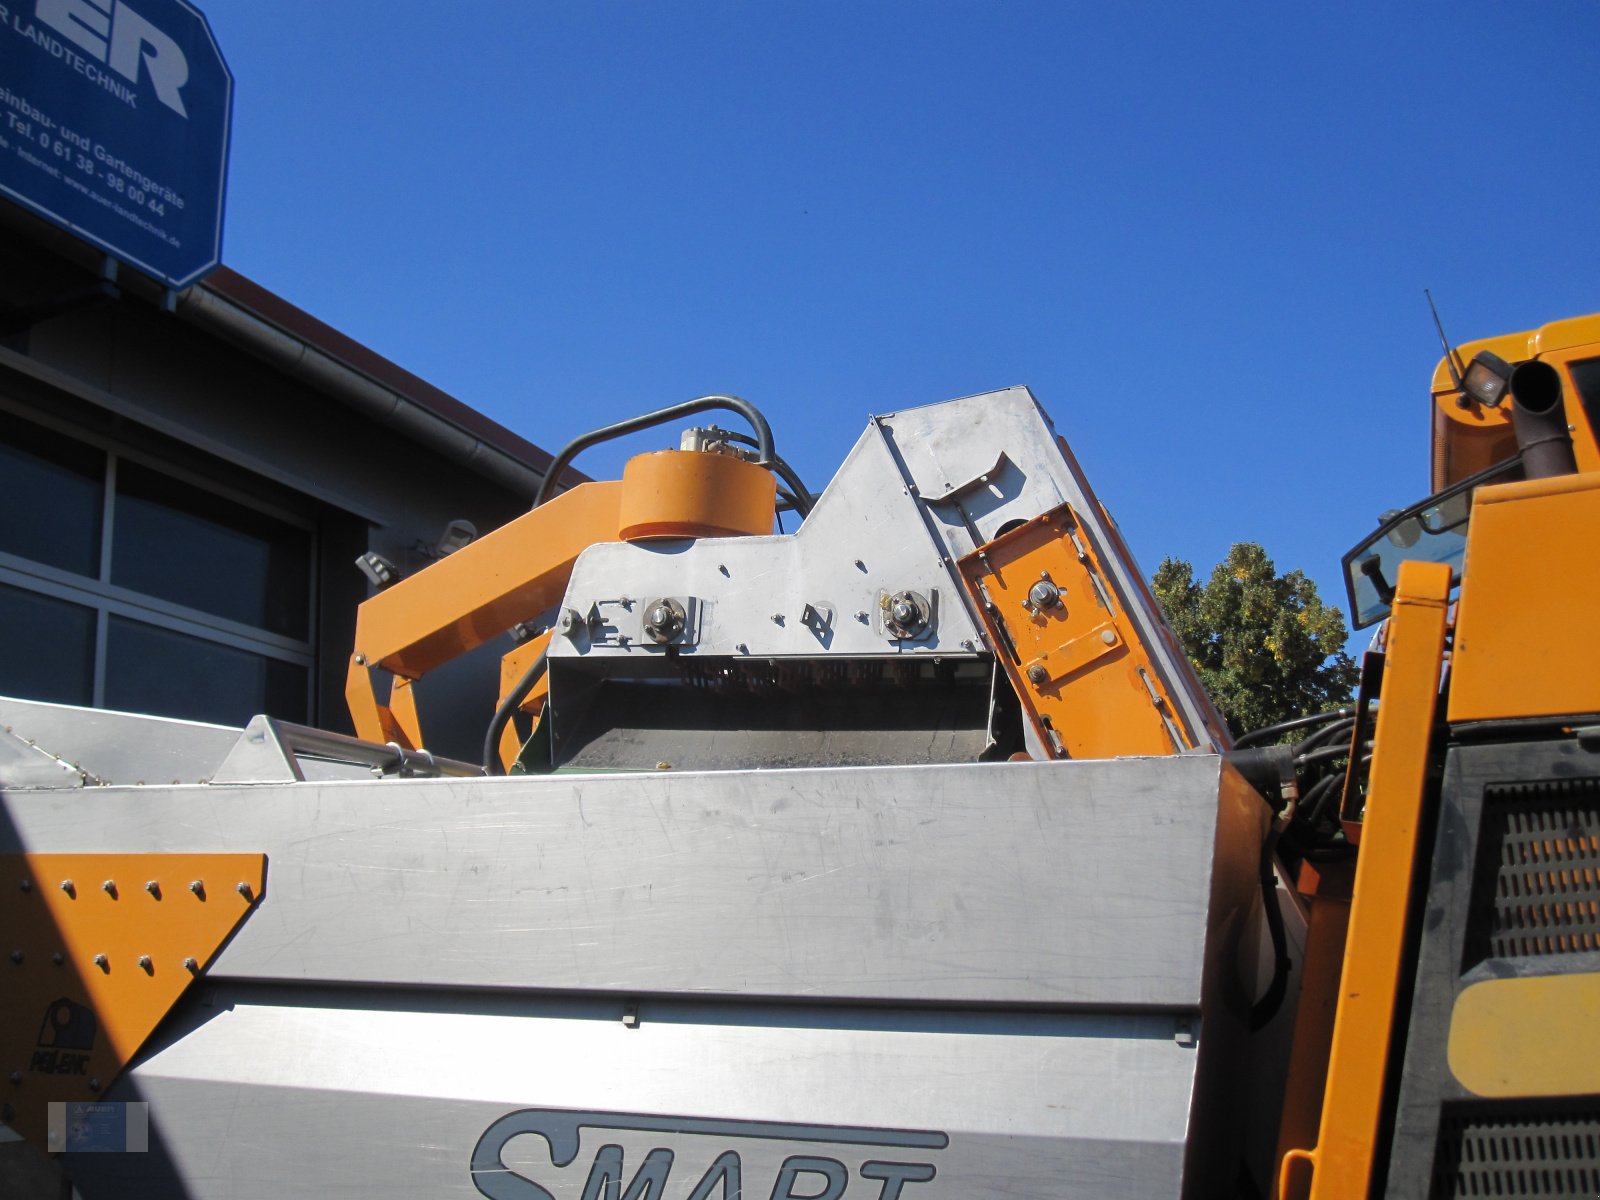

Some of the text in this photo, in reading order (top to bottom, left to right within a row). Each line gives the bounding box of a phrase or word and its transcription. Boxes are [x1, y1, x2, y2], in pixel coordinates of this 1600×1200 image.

[13, 15, 137, 109] LANDTECHNIK
[7, 112, 34, 140] Tel.
[39, 132, 50, 148] 0
[53, 141, 71, 161] 61
[76, 154, 94, 175] 38
[107, 173, 125, 193] 98
[128, 185, 145, 204] 00
[148, 198, 165, 216] 44
[60, 126, 90, 152] und
[94, 144, 185, 209] Gartengeräte
